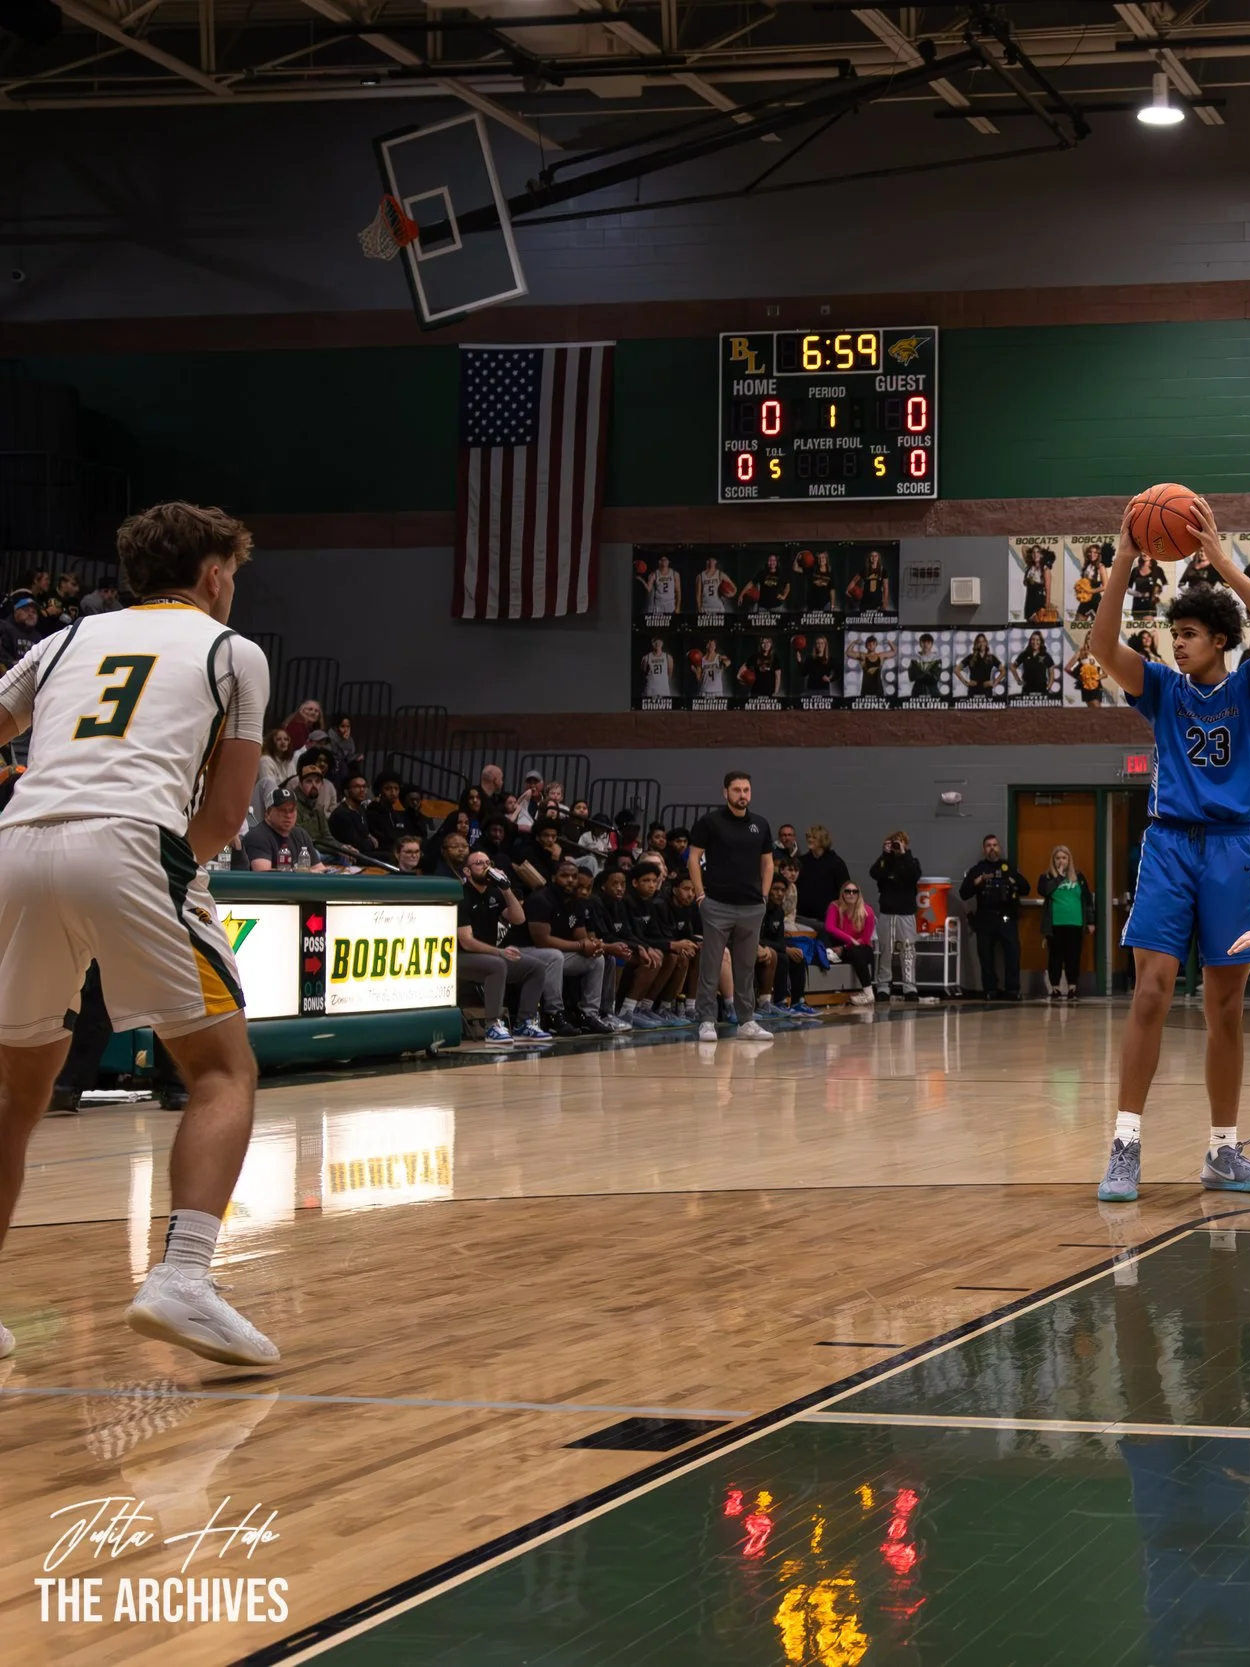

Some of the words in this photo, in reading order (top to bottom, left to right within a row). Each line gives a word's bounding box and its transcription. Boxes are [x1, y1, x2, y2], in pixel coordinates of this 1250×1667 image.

[803, 334, 876, 370] 6:59
[733, 379, 777, 395] HOME
[875, 375, 926, 392] GUEST
[809, 387, 846, 398] PERIOD
[762, 401, 780, 434] 0
[907, 397, 926, 430] 0
[725, 440, 758, 451] FOULS
[794, 438, 833, 450] PLAYER
[836, 437, 863, 449] FOUL
[898, 436, 931, 447] FOULS
[738, 454, 752, 480] 0
[910, 450, 926, 476] 0
[725, 486, 758, 497] SCORE
[809, 485, 845, 496] MATCH
[897, 483, 931, 493] SCORE
[1016, 537, 1059, 545] BOBCATS
[1126, 621, 1169, 629] BOBCATS
[72, 654, 160, 740] 3
[1186, 726, 1230, 767] 23
[1127, 756, 1147, 772] EXIT
[304, 936, 324, 952] POSS
[330, 936, 455, 983] BOBCATS
[304, 997, 324, 1011] BONUS
